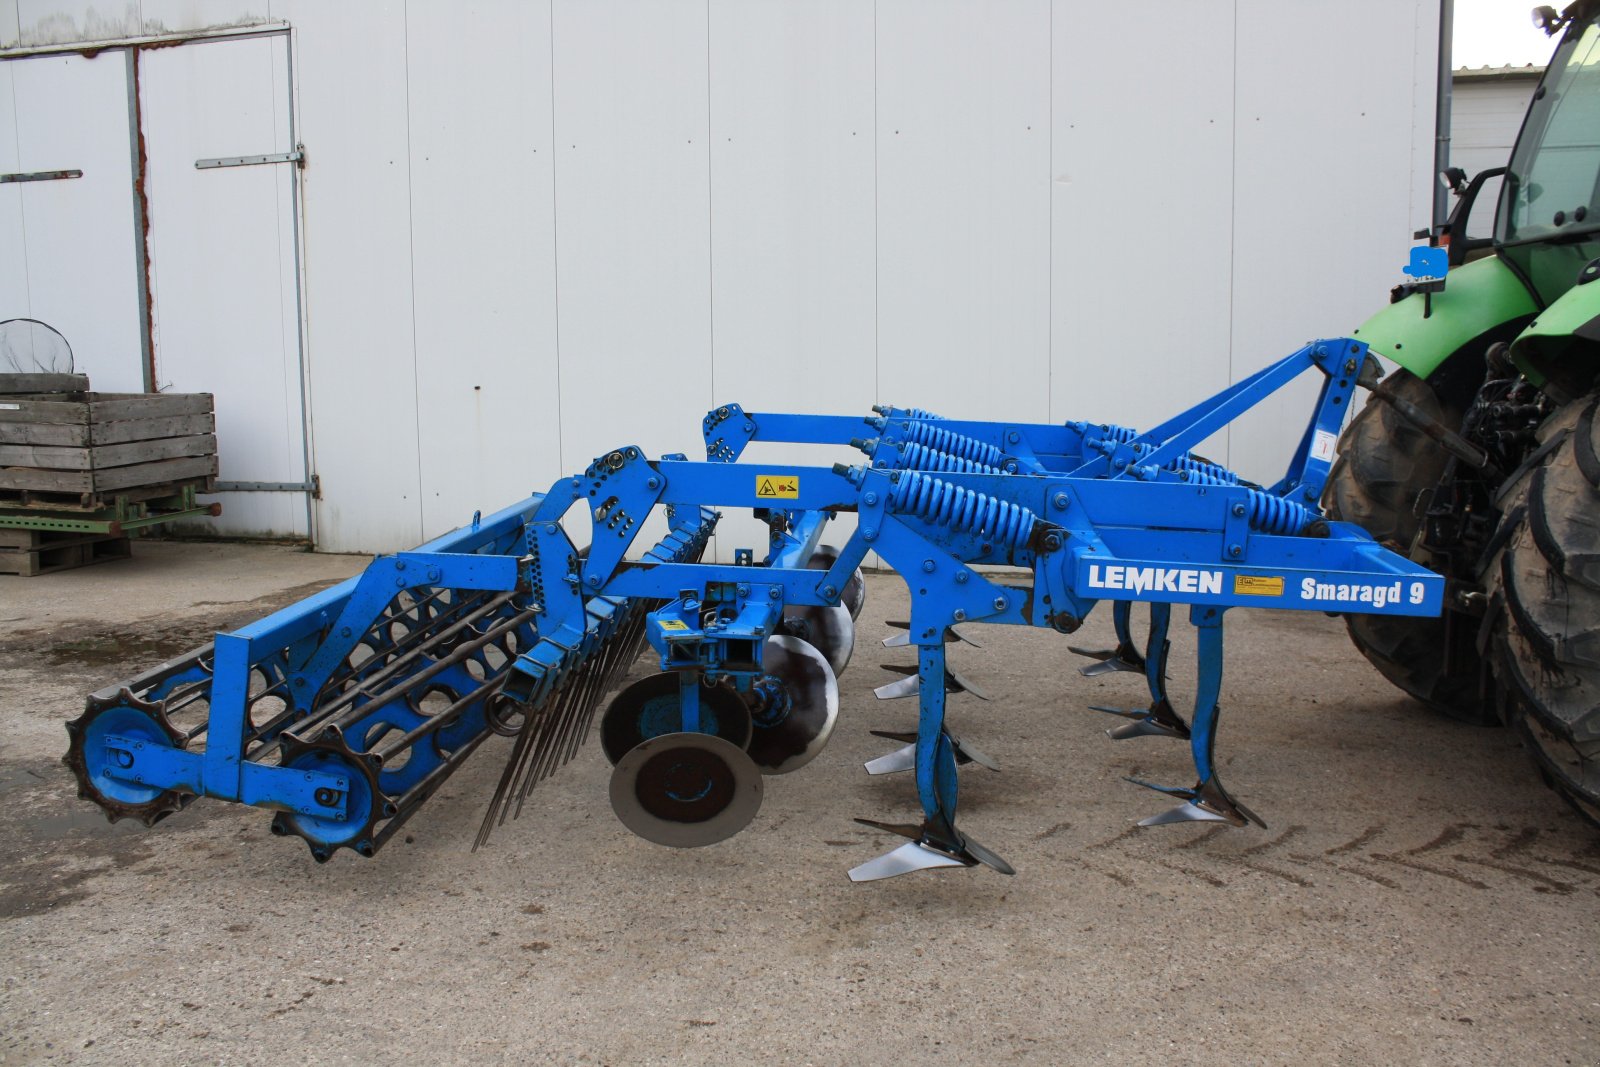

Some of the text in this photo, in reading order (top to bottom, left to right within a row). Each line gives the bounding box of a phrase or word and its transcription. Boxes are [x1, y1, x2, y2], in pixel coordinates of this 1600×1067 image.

[1088, 565, 1223, 595] LEMKEN
[1301, 577, 1425, 608] Smaragd 9
